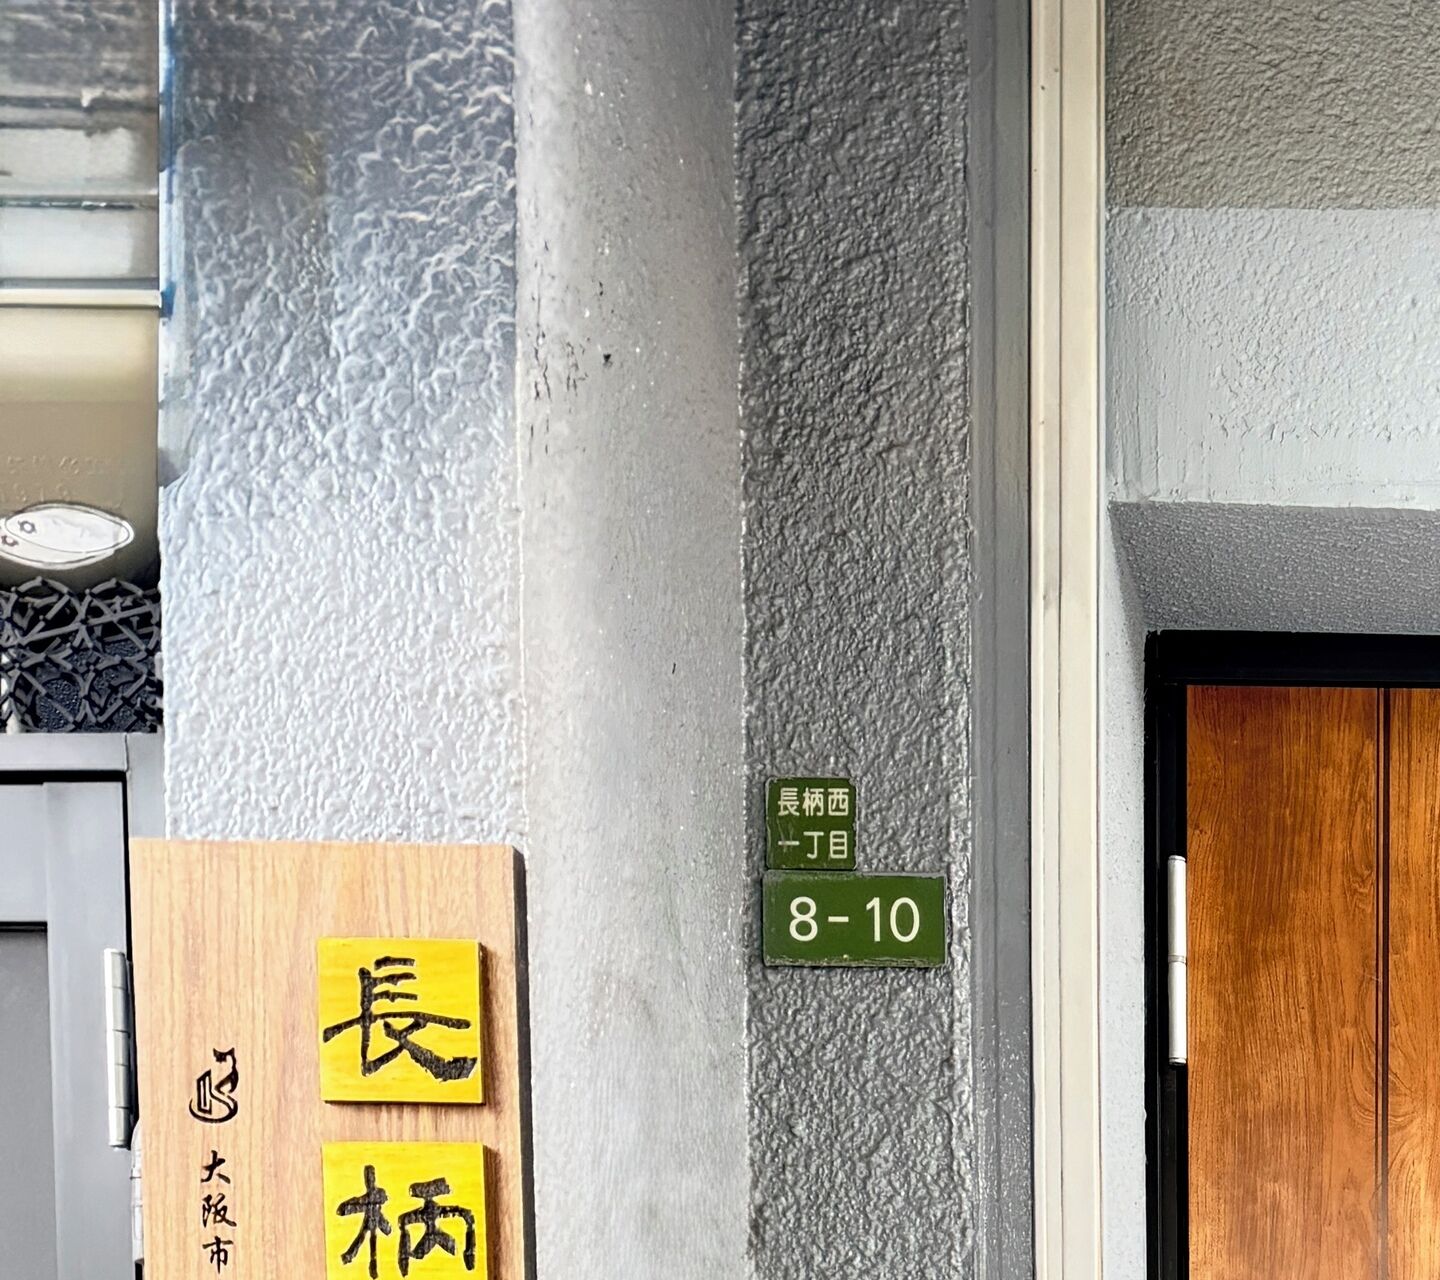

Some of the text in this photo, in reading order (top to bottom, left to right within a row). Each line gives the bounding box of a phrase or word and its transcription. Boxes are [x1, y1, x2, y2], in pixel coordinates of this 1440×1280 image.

[778, 787, 849, 816] 長柄西
[778, 831, 848, 859] 一丁目
[789, 897, 920, 942] 8-10
